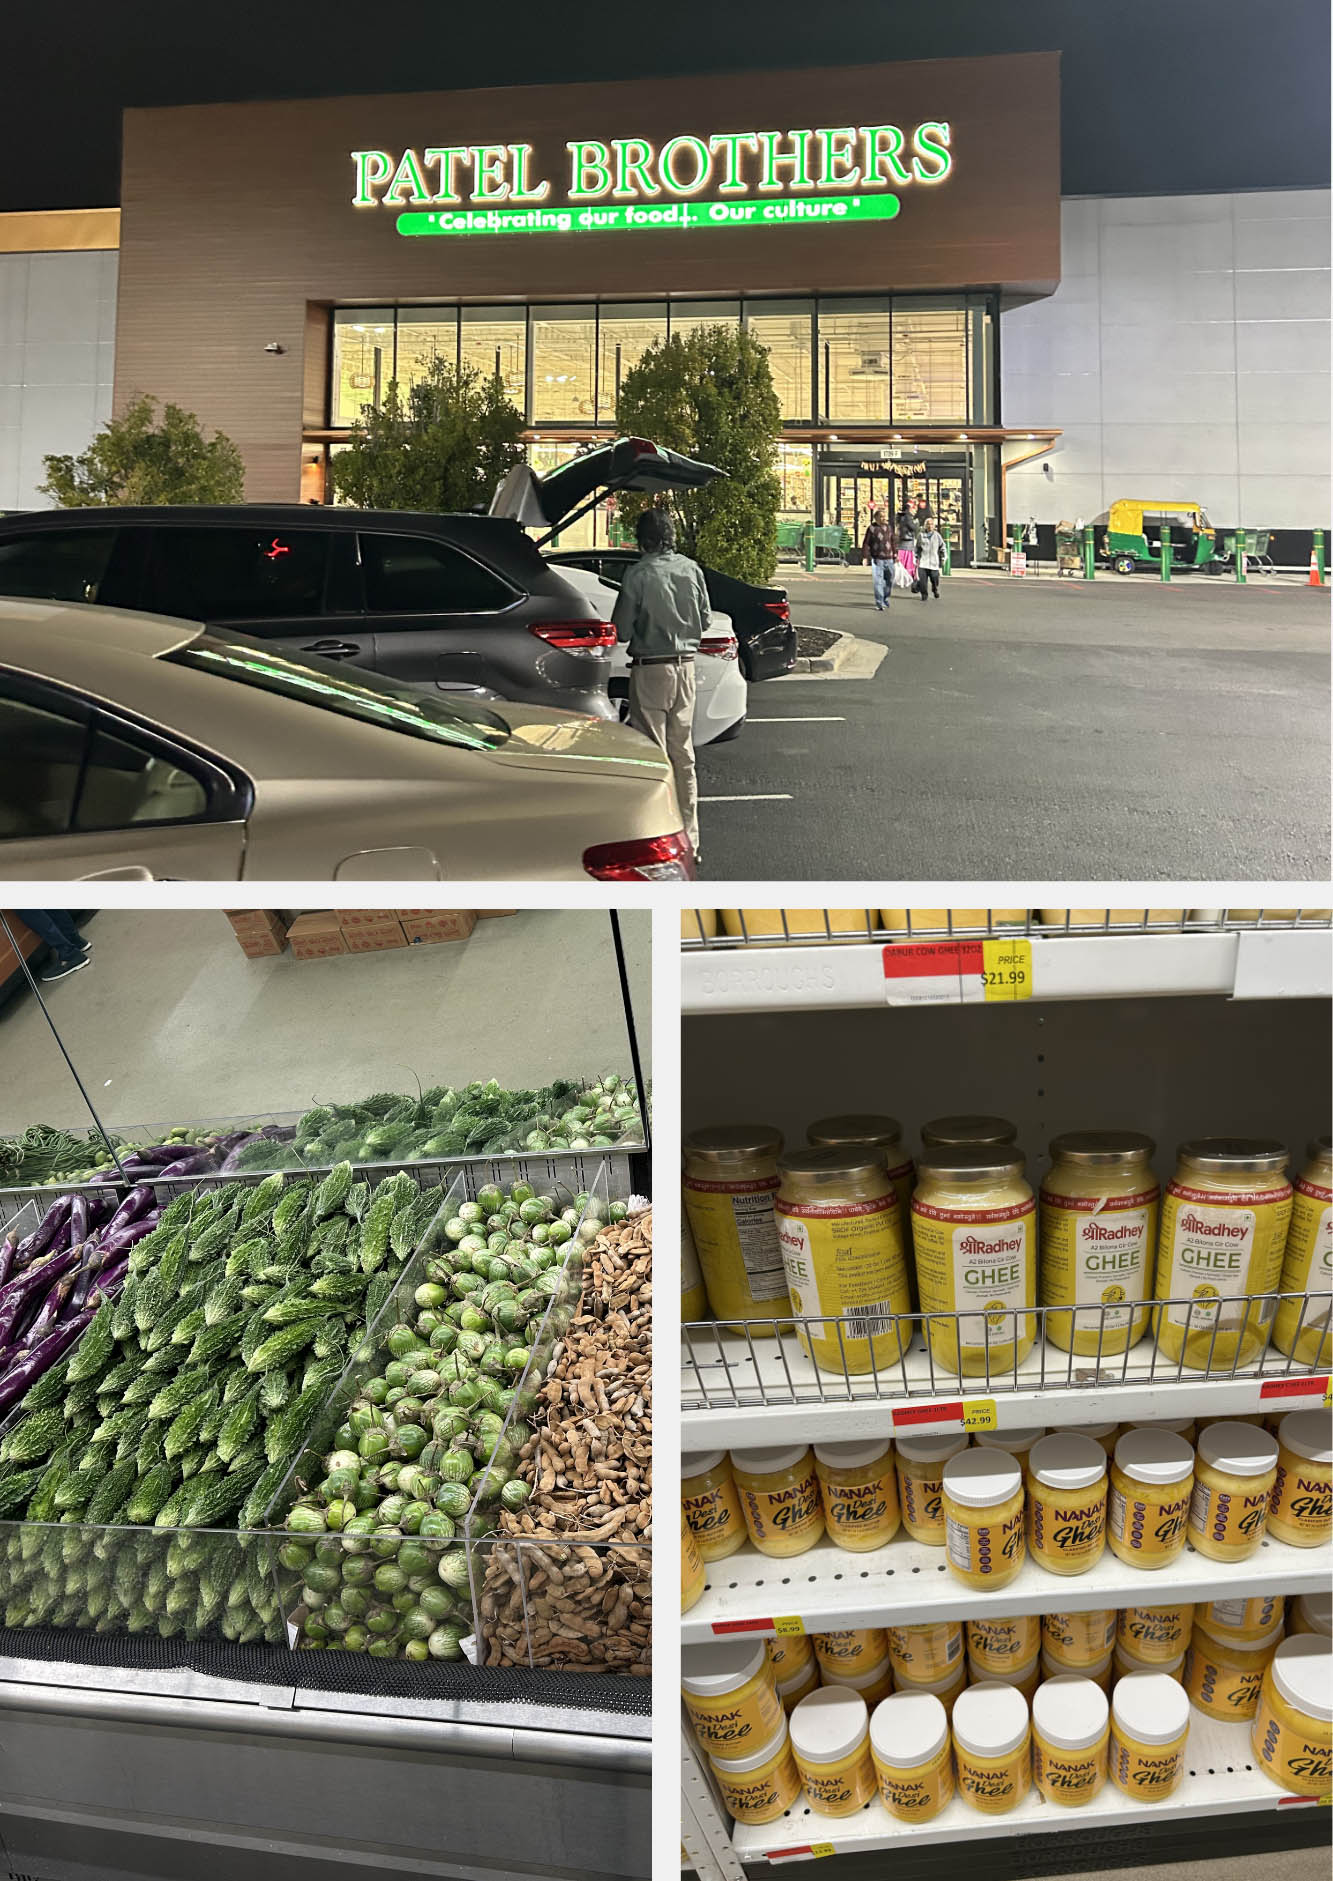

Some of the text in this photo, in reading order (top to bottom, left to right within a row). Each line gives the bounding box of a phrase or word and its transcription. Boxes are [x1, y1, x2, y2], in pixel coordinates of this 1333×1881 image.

[351, 121, 952, 206] PATEL BROTHERS
[579, 211, 619, 227] our
[708, 203, 756, 220] Our
[998, 955, 1025, 965] PRICE
[981, 970, 1026, 986] $21.99
[1085, 1249, 1140, 1271] GHEE
[1181, 1247, 1242, 1270] GHEE
[964, 1263, 1020, 1285] GHEE
[960, 1415, 991, 1427] $42.99
[827, 1480, 883, 1500] NANAK
[831, 1500, 887, 1524] Ghee
[853, 1496, 877, 1510] Desi
[1133, 1608, 1180, 1623] NANAK
[1128, 1621, 1183, 1641] Ghee
[970, 1632, 1021, 1654] Ghee
[713, 1720, 738, 1731] Desi
[963, 1764, 1008, 1779] NANAK
[1049, 1759, 1095, 1773] NANAK
[962, 1776, 1013, 1796] Ghee
[1046, 1771, 1098, 1788] Ghee
[744, 1791, 768, 1801] Desi
